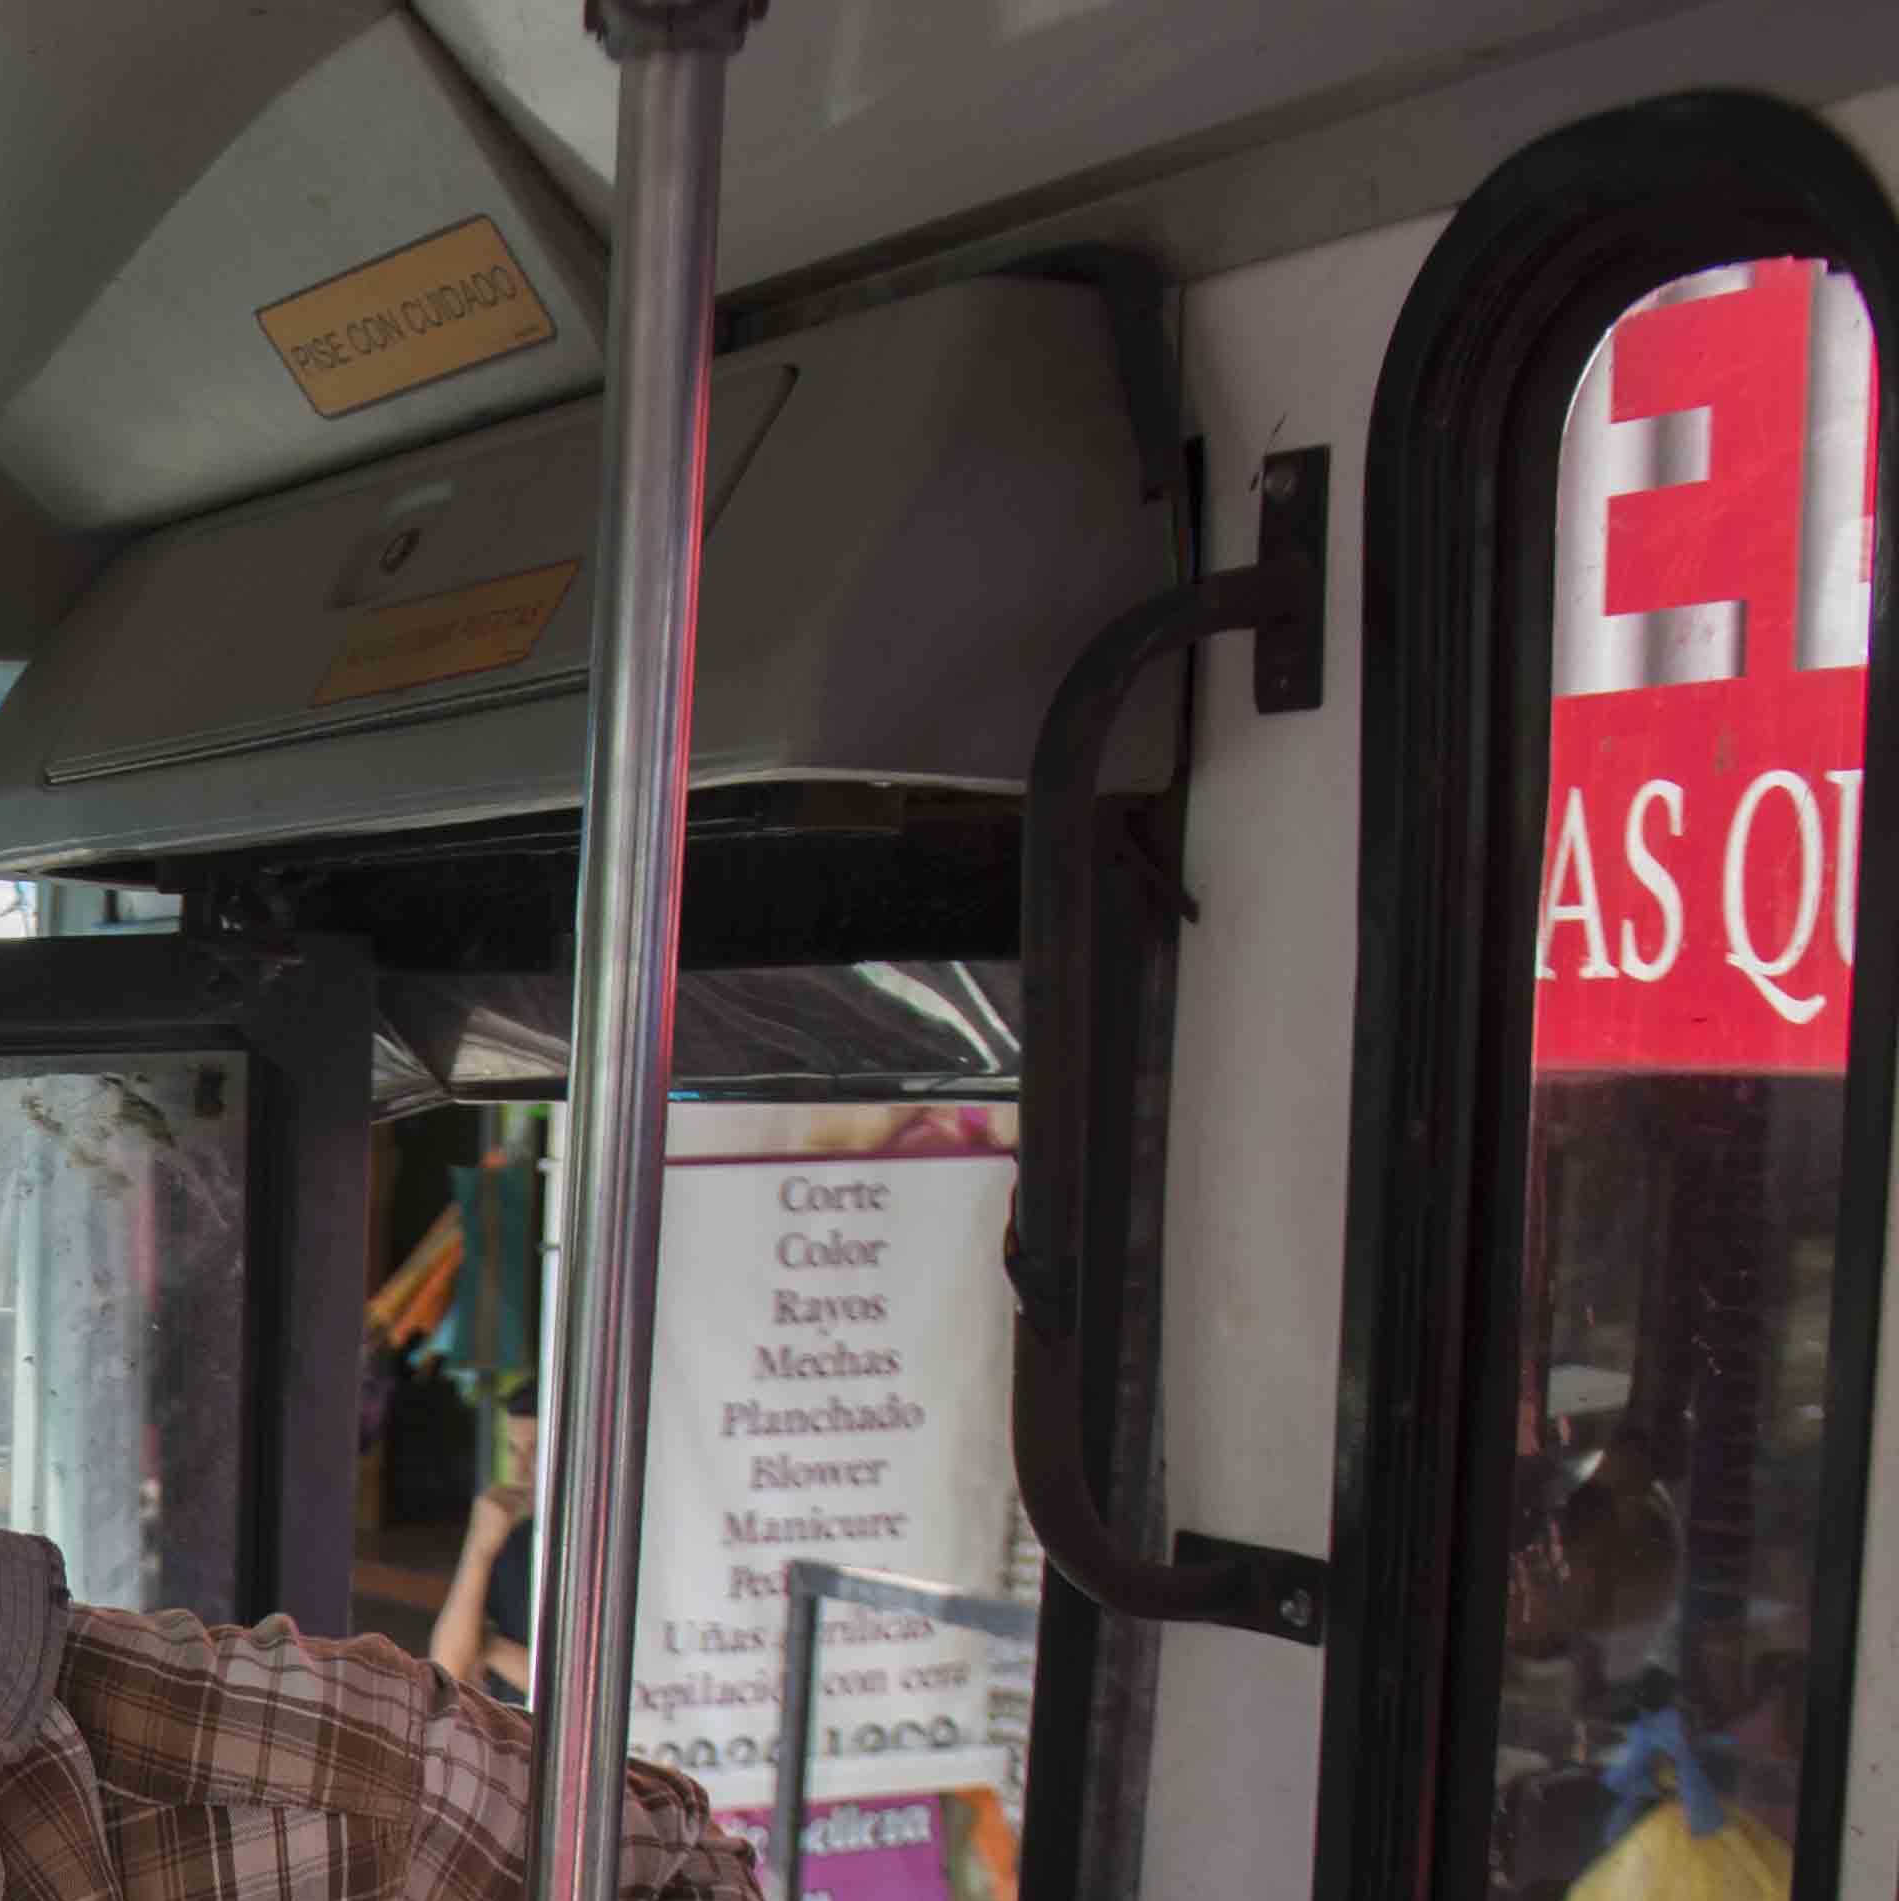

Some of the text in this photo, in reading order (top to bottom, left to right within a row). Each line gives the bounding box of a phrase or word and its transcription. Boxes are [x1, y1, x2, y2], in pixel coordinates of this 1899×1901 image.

[292, 265, 516, 374] PISE CON CUIDADO
[777, 1175, 891, 1214] Corte
[774, 1229, 890, 1271] Color
[771, 1289, 888, 1336] Rayos
[752, 1338, 902, 1381] Mechas
[719, 1395, 925, 1440] Planchado
[748, 1452, 889, 1492] Blower
[721, 1507, 908, 1546] Manicure
